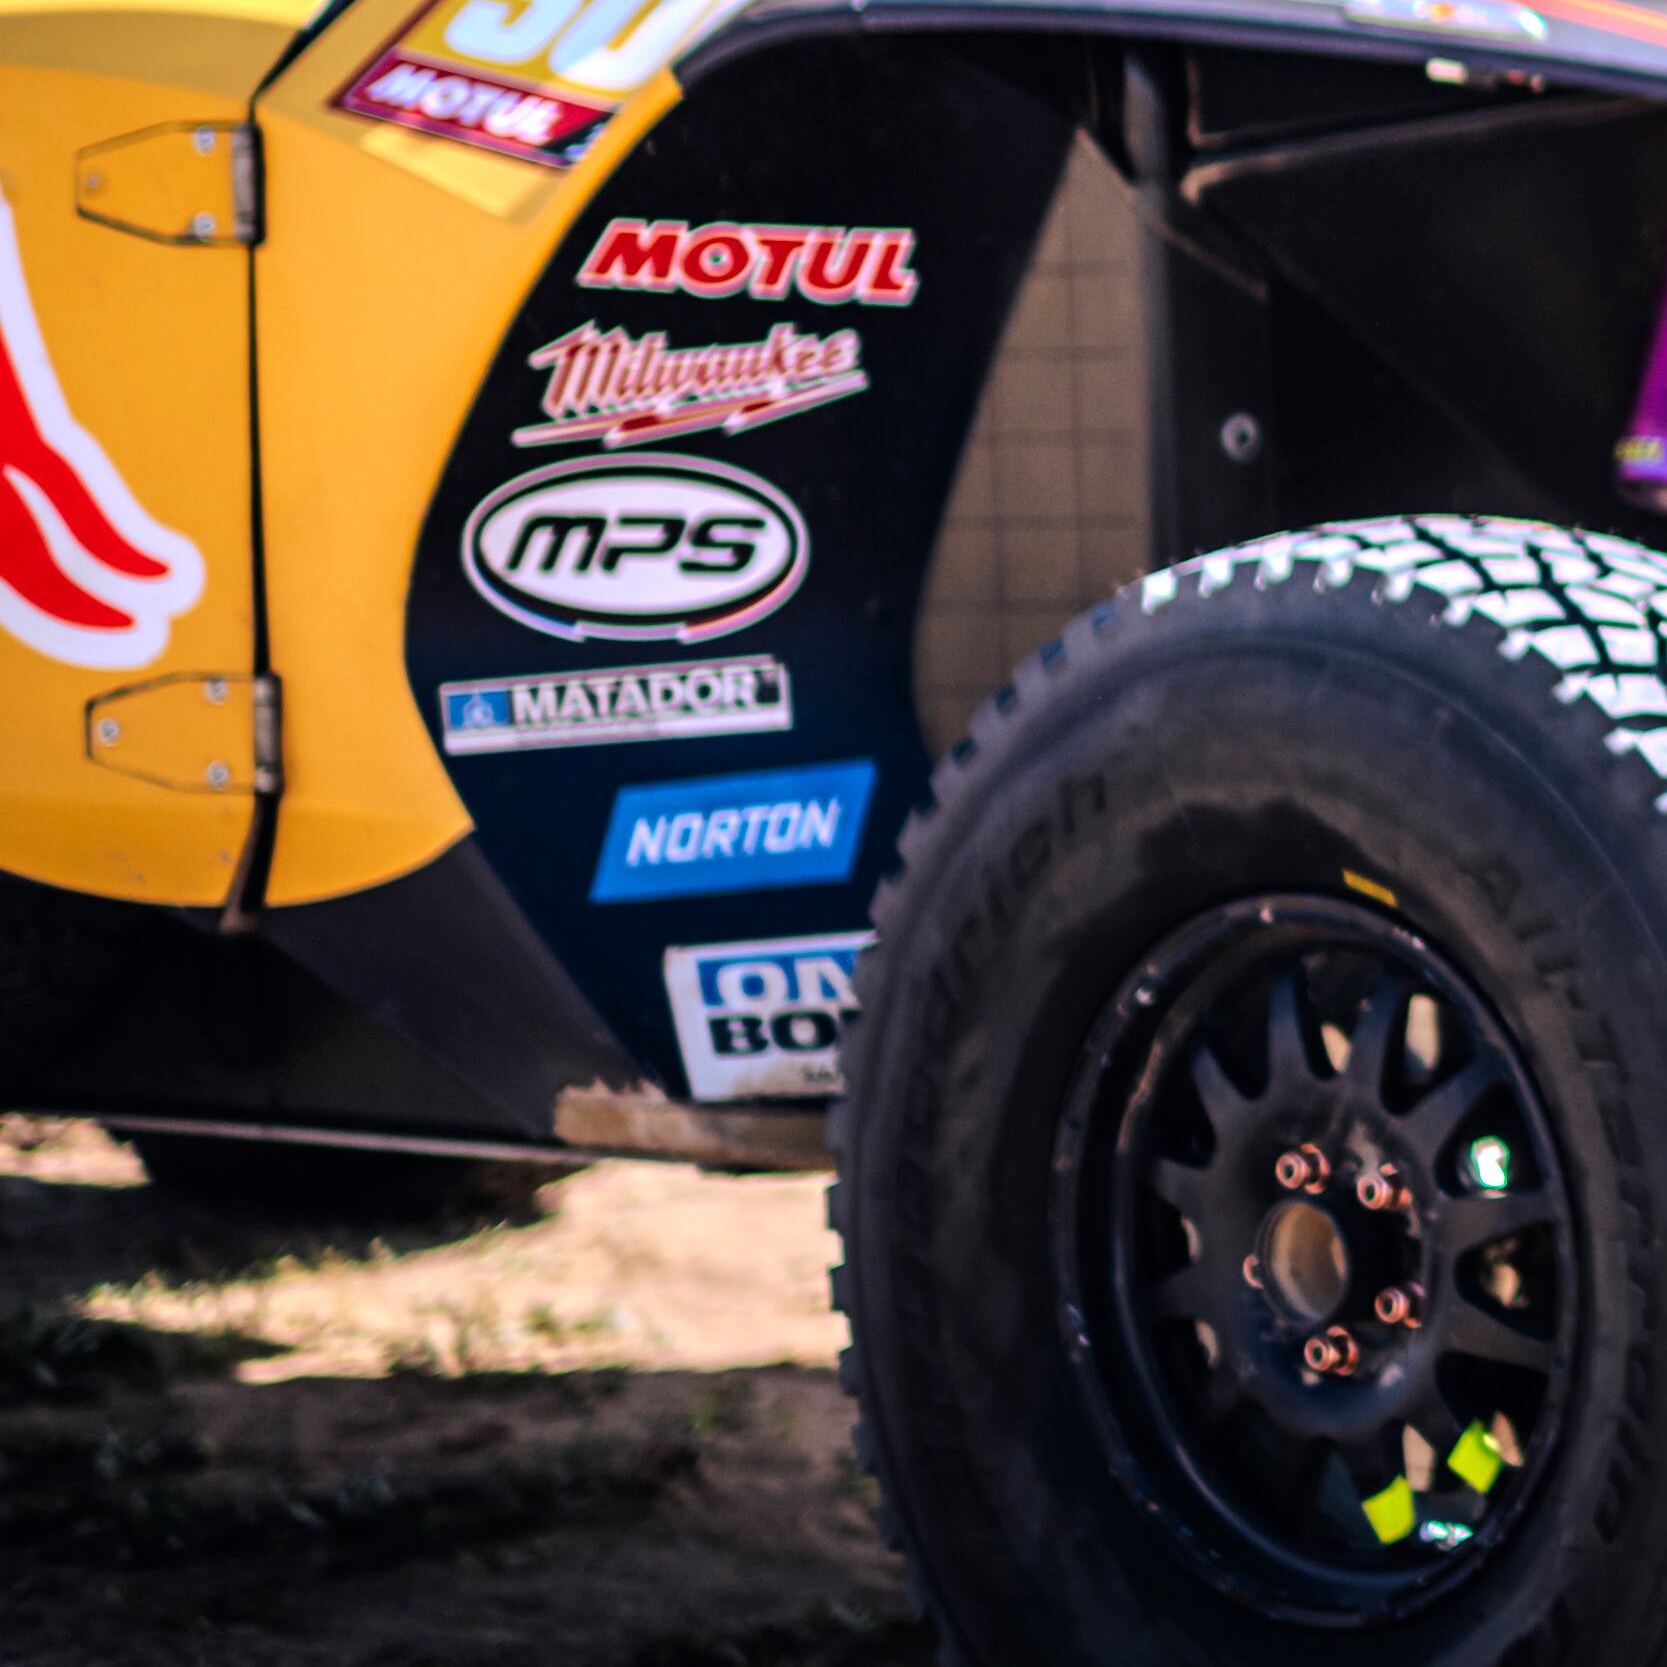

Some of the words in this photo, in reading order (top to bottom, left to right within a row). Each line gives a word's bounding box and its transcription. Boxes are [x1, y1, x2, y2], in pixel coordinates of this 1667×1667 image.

[366, 63, 564, 145] MOTUL
[577, 218, 919, 306] MOTUL
[528, 319, 861, 418] Milwaukee
[506, 514, 767, 575] MPS
[512, 665, 757, 725] MATADOR
[626, 795, 843, 867] NORTON
